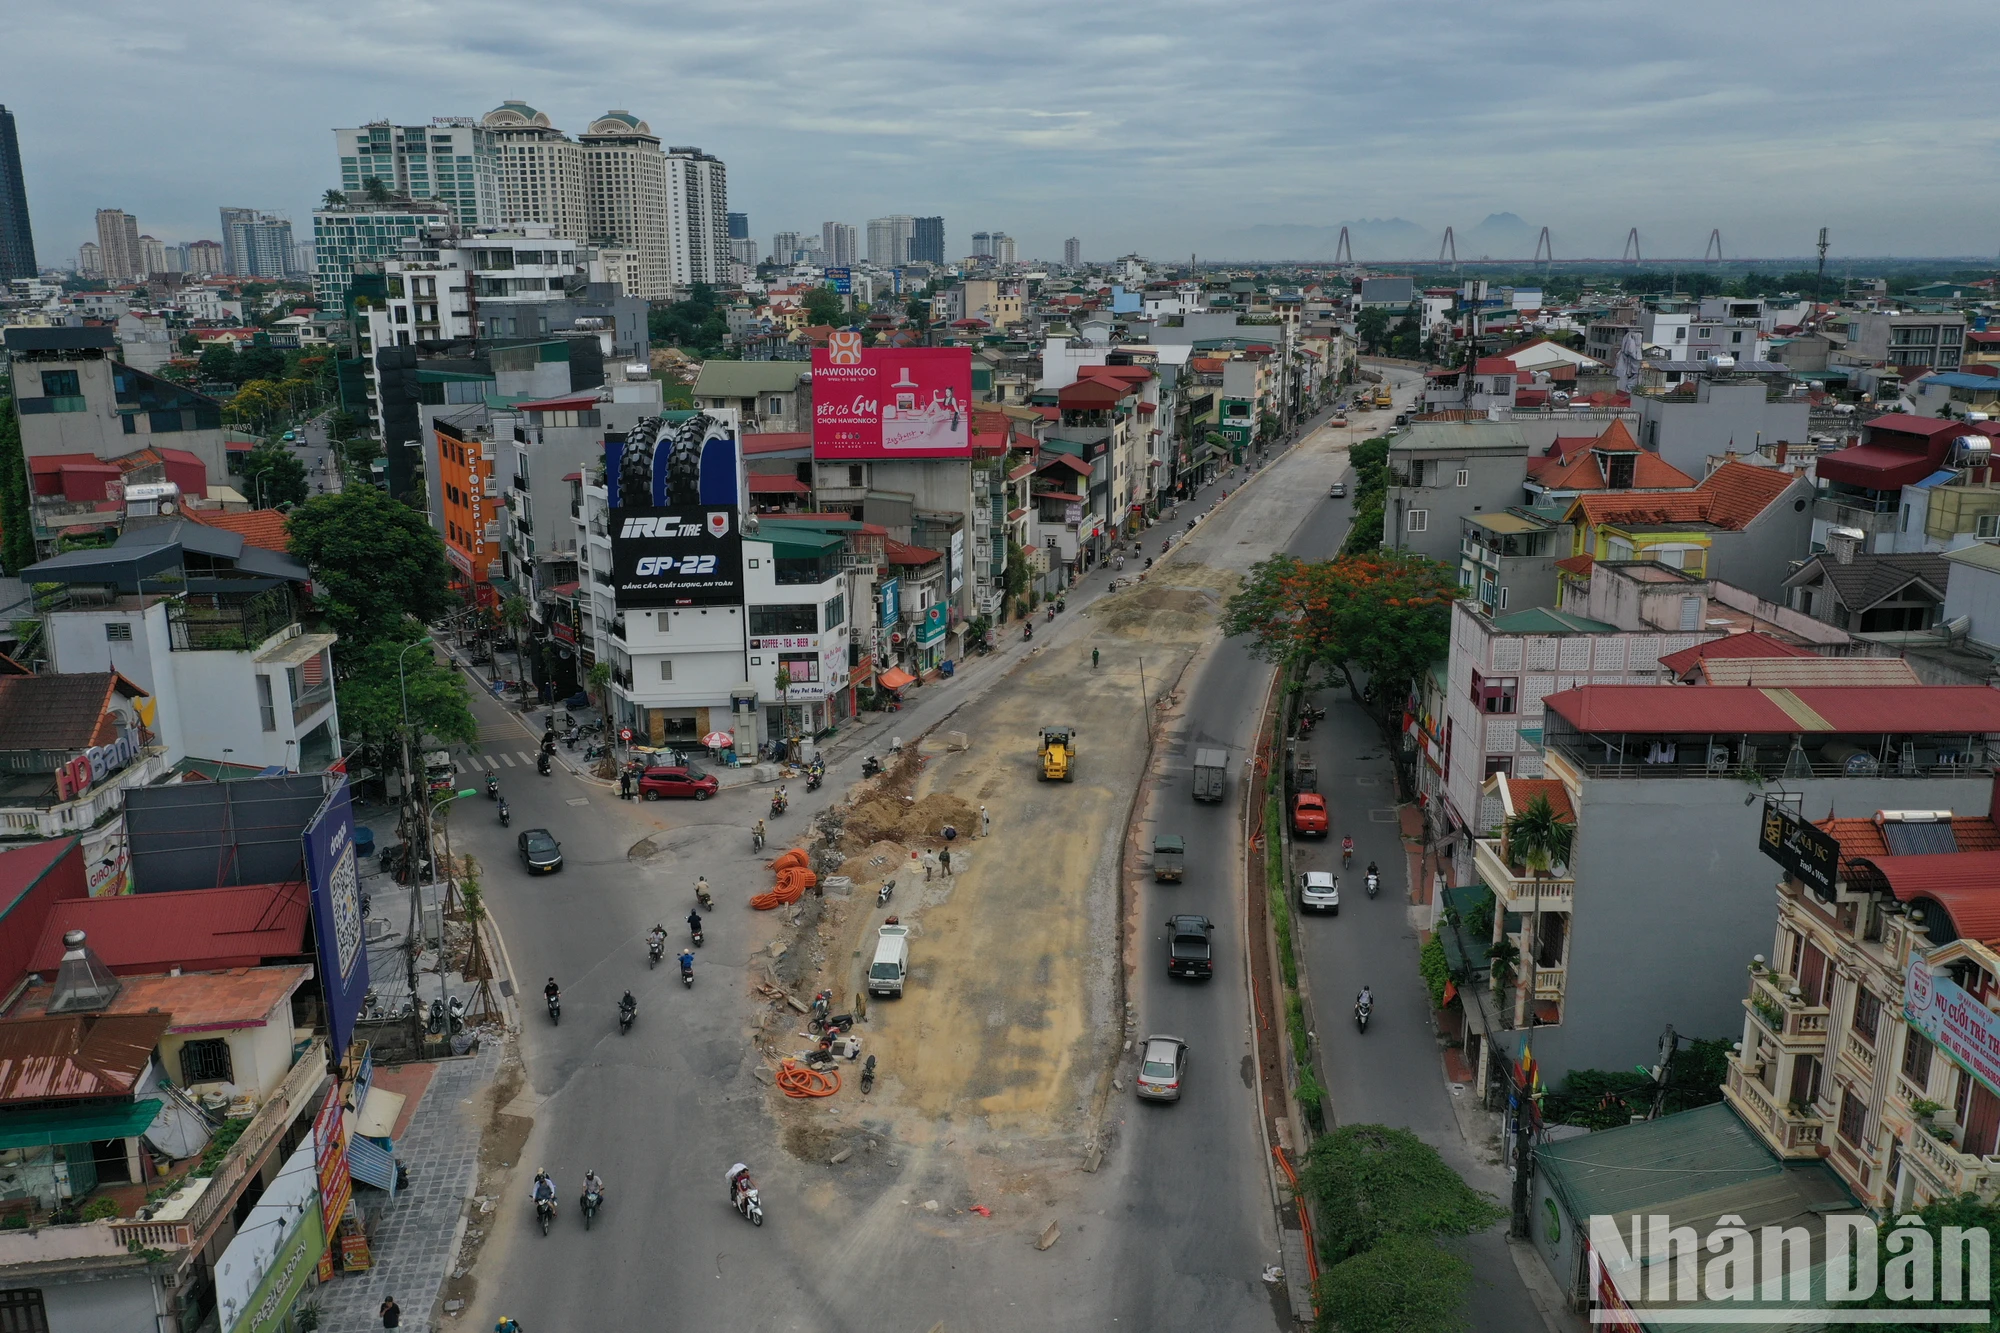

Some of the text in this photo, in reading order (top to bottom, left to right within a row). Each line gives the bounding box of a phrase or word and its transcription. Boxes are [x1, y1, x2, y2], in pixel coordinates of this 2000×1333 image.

[814, 367, 877, 376] HAWONKOO
[817, 402, 835, 416] BẾP
[467, 448, 477, 474] PET
[470, 486, 484, 554] HOSPITAL
[620, 516, 703, 539] IRC TIRE
[636, 554, 719, 576] GP-22
[622, 582, 642, 590] ĐẲNG
[659, 581, 677, 589] CHẤT
[762, 639, 778, 649] COFFEE
[784, 638, 792, 648] TEA
[797, 638, 809, 647] BEER
[55, 727, 141, 801] HDBank
[1813, 843, 1829, 862] JSC
[1799, 859, 1812, 873] Food
[1815, 869, 1829, 885] Wine
[1935, 991, 1948, 1018] NỤ
[1970, 1021, 1987, 1045] TRẺ
